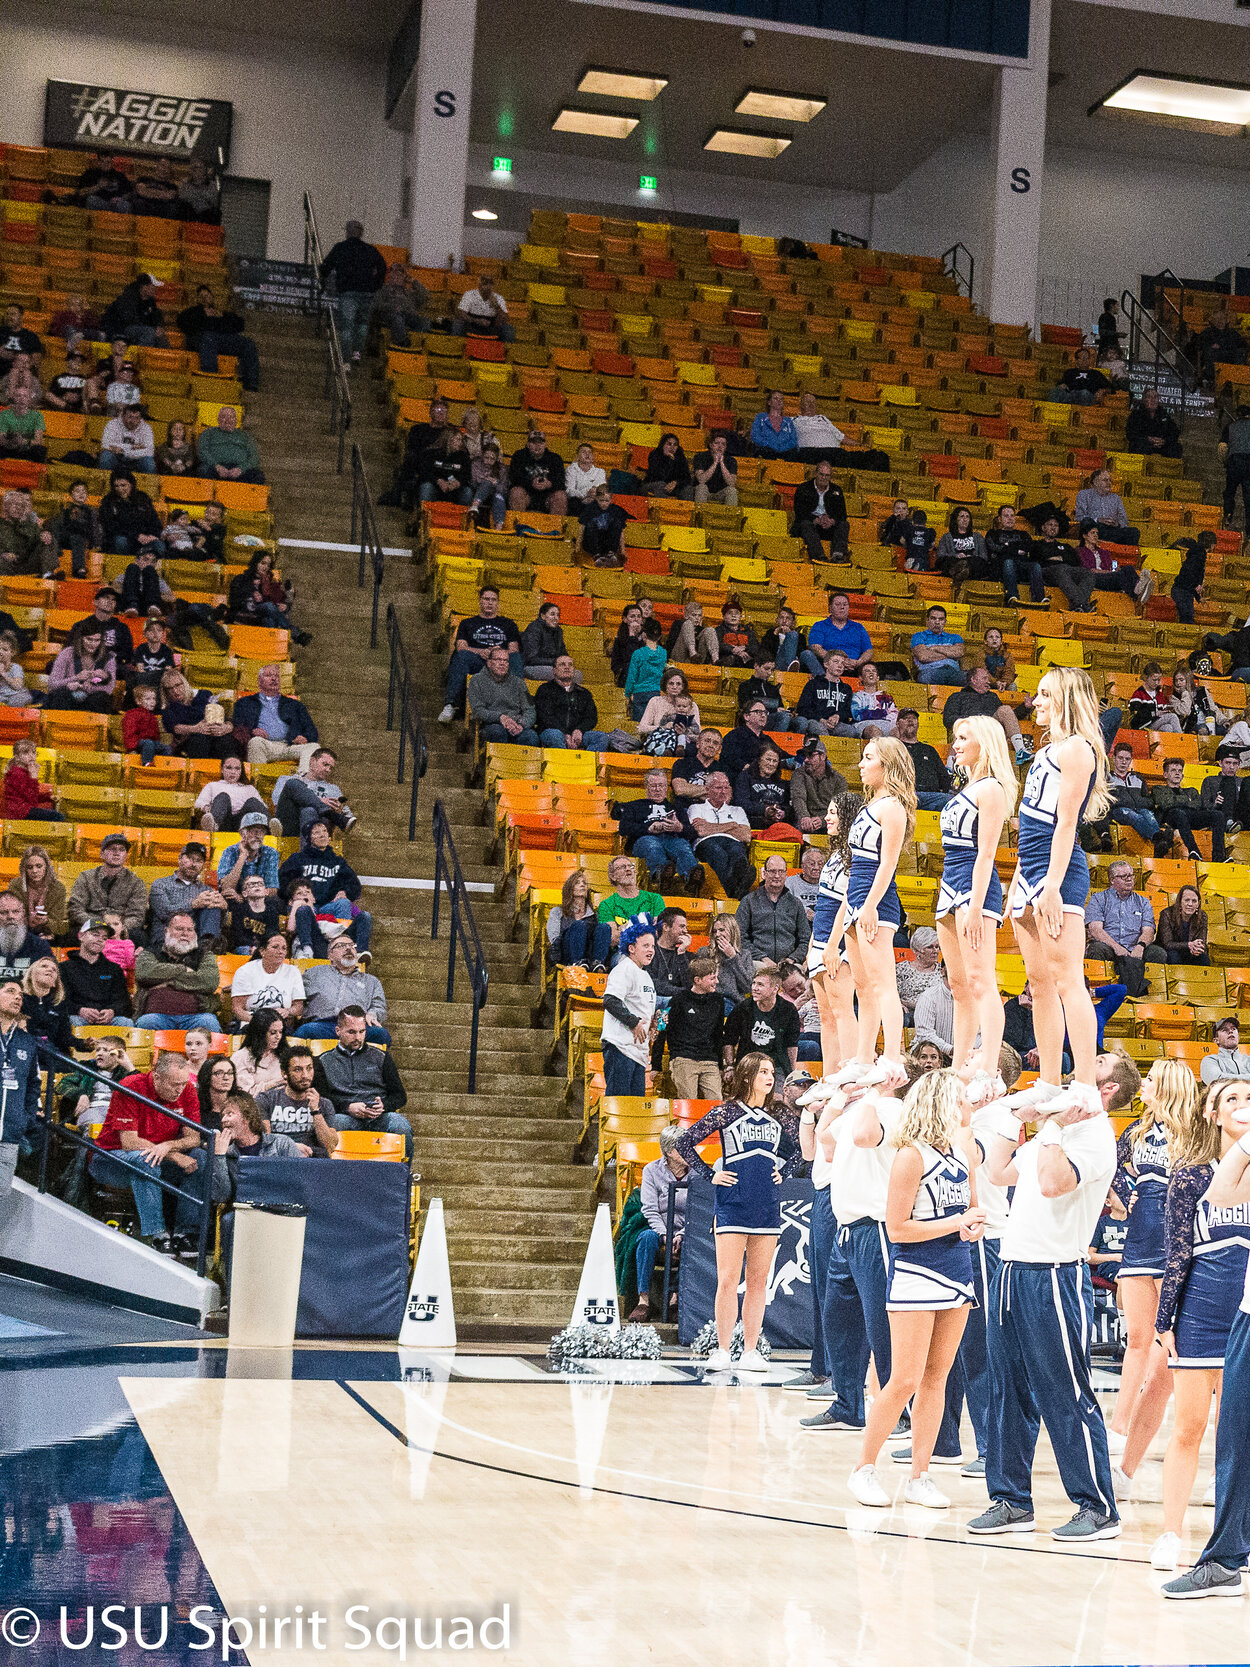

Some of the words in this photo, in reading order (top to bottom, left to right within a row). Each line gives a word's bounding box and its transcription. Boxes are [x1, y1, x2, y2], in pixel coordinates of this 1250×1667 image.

[433, 90, 457, 118] S
[77, 112, 203, 149] NATION
[1010, 167, 1031, 193] S
[817, 688, 831, 700] UTAH
[271, 1105, 314, 1122] AGGI
[644, 1101, 652, 1109] 19
[741, 1120, 778, 1144] AGGIES
[939, 1174, 971, 1208] AGGIE
[408, 1302, 440, 1314] STATE
[584, 1306, 617, 1317] STATE
